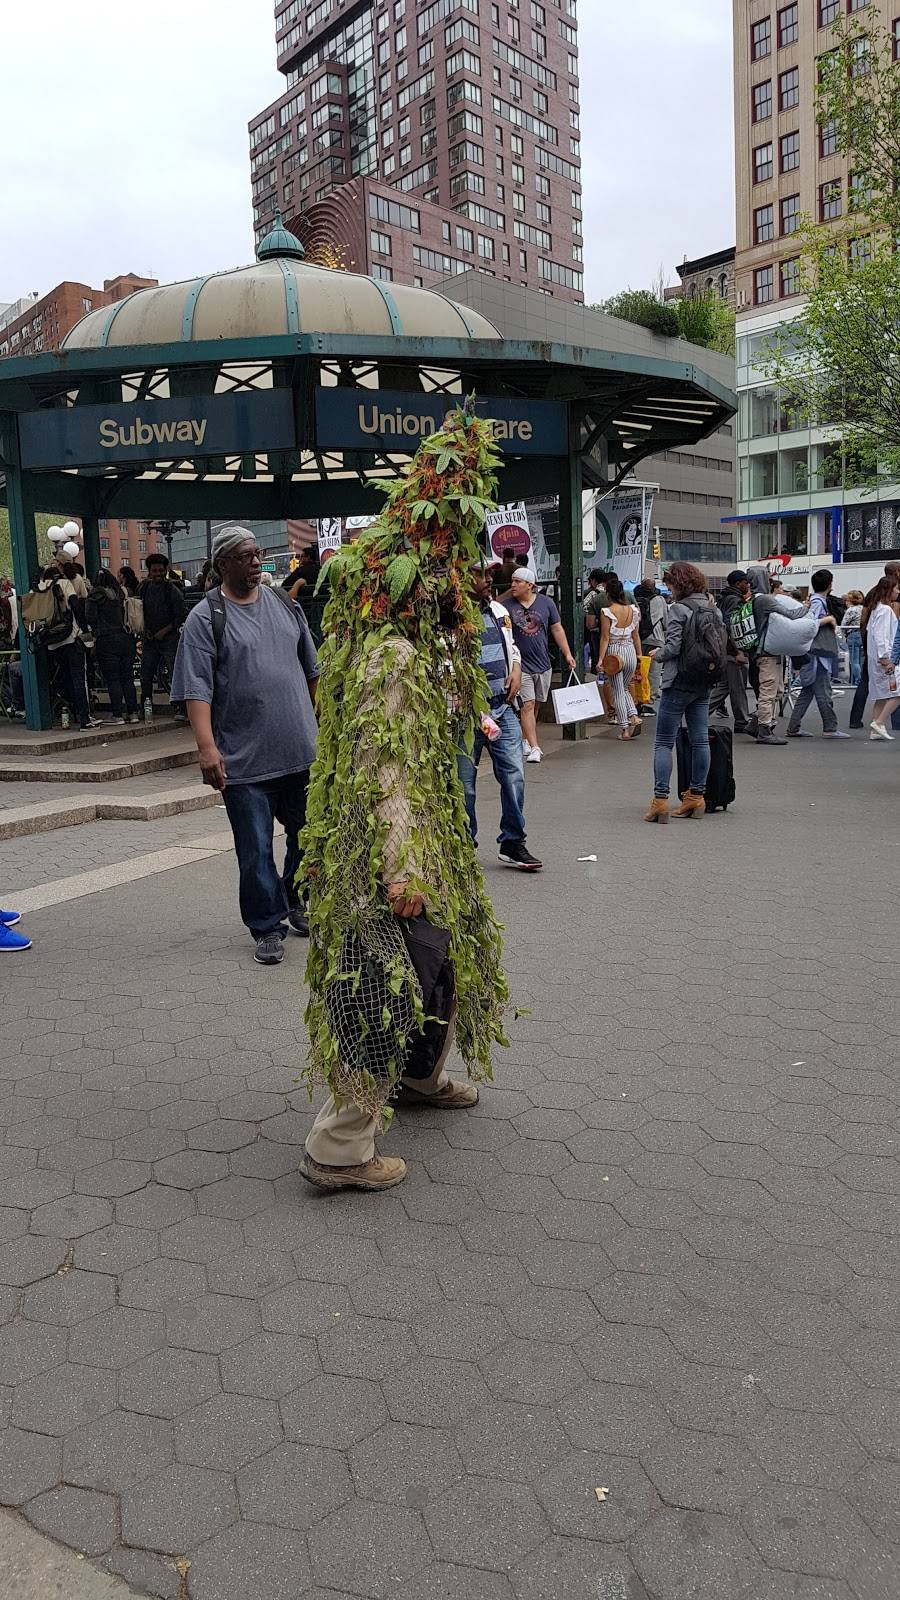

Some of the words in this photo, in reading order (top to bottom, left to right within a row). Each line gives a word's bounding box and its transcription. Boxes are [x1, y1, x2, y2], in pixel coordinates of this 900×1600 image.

[358, 405, 435, 436] Union
[99, 418, 207, 448] Subway
[487, 512, 504, 526] SENSI
[504, 511, 526, 523] SEEDS
[615, 547, 630, 556] SENSI
[630, 546, 641, 555] SEE
